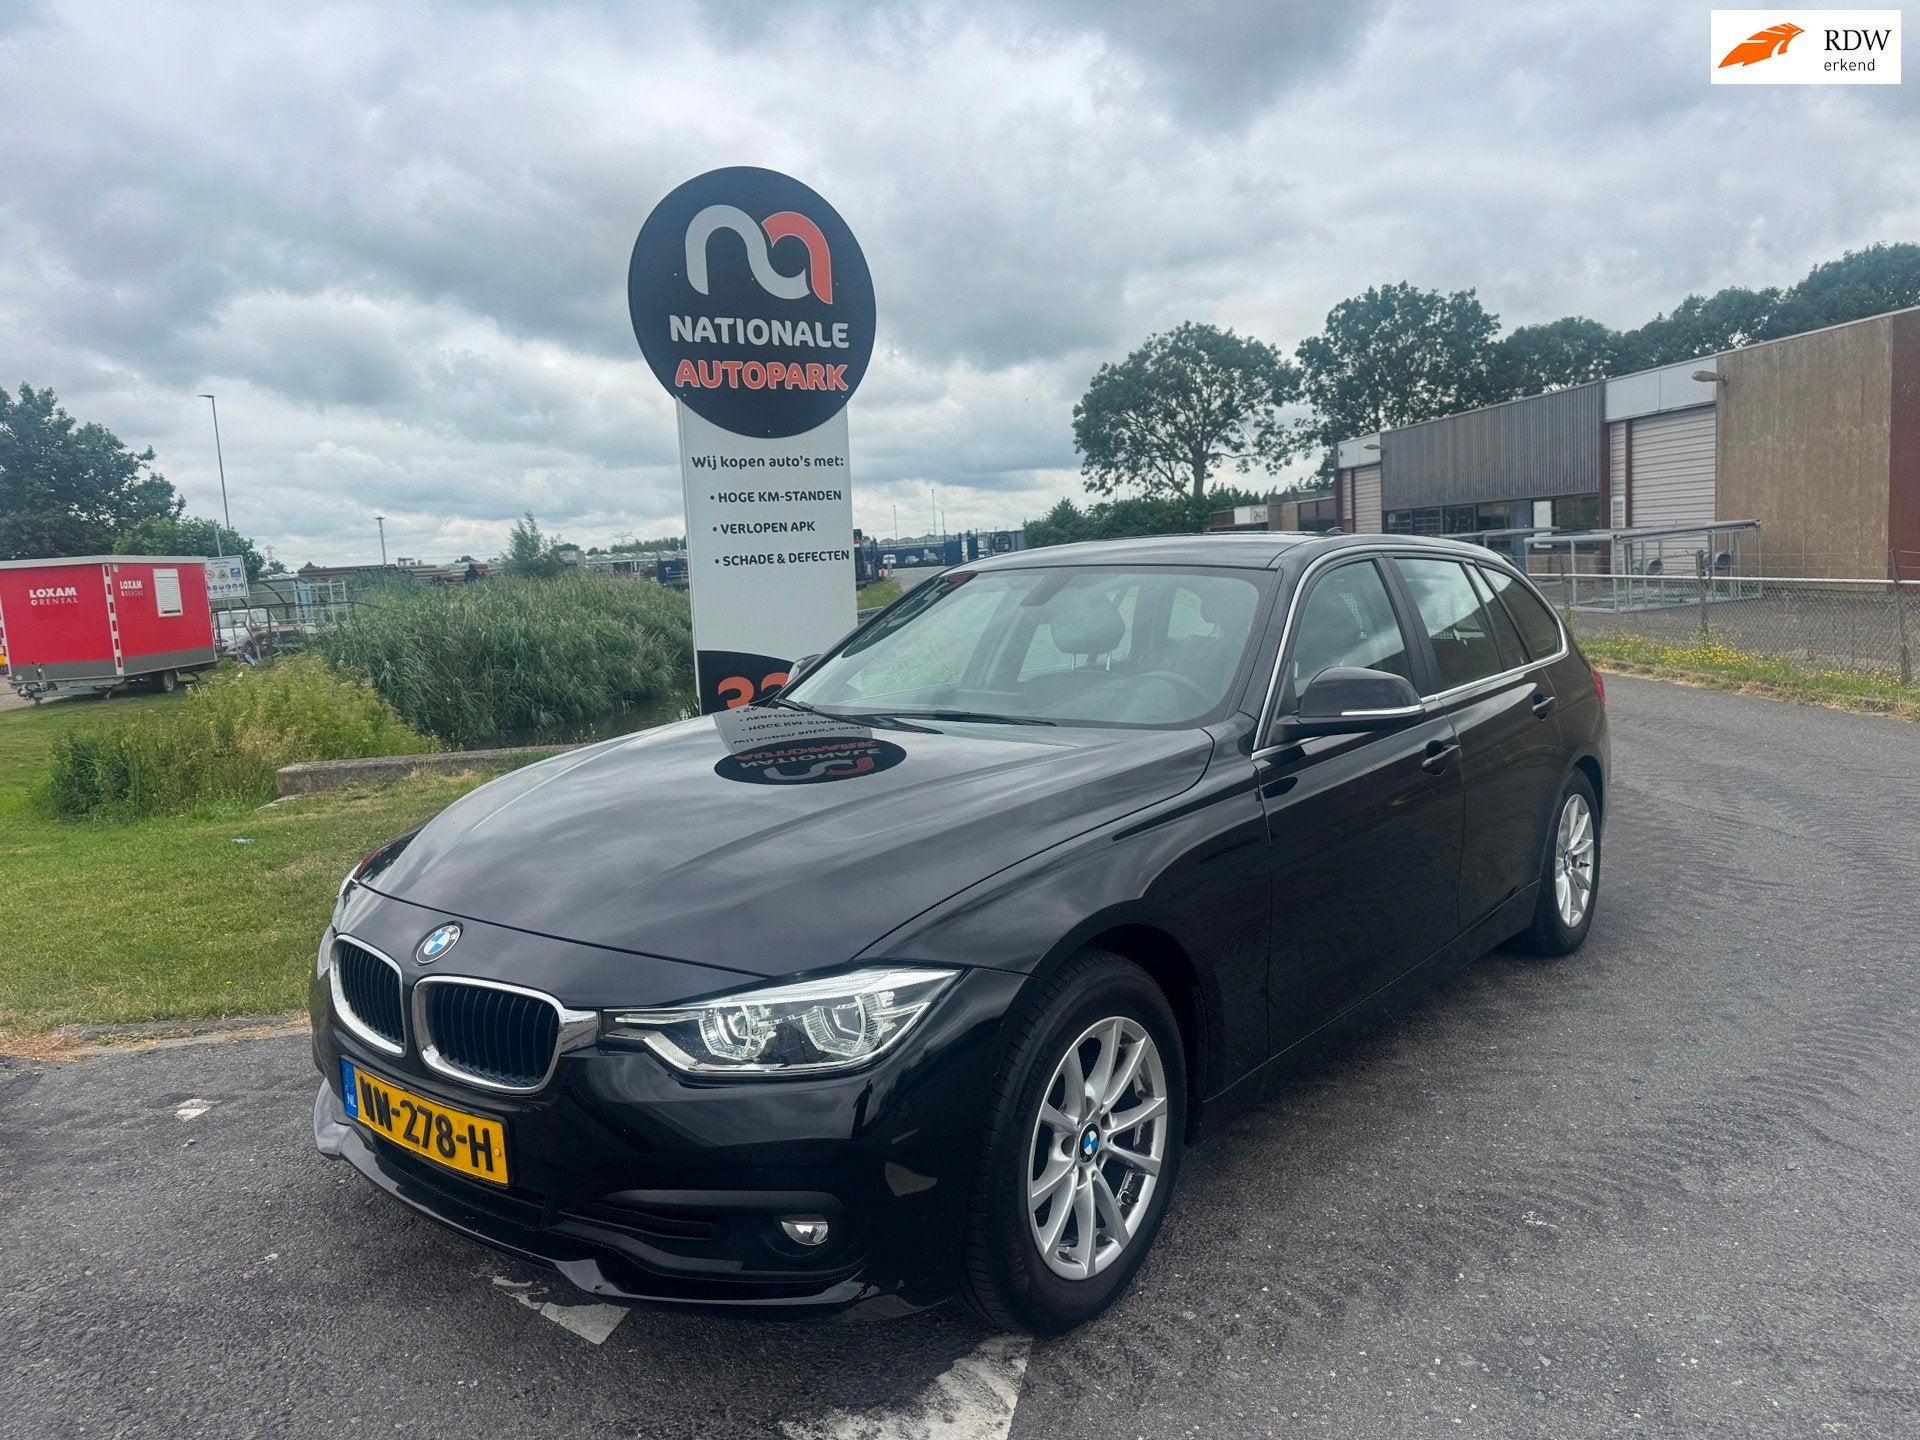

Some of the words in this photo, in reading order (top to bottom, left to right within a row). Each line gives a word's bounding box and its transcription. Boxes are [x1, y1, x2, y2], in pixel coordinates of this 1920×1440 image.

[669, 314, 850, 349] NATIONALE
[674, 358, 849, 391] AUTOPARK
[691, 454, 718, 471] Wij
[720, 455, 765, 470] kopen
[768, 454, 811, 468] auto's
[814, 456, 844, 467] met:
[718, 491, 755, 503] HOGE
[758, 490, 842, 502] KM-STANDEN
[720, 522, 788, 534] VERLOPEN
[790, 520, 816, 532] APK
[722, 553, 775, 567] SCHADE
[776, 553, 786, 564] &
[788, 549, 850, 563] DEFECTEN
[119, 580, 143, 589] LOXAM
[29, 586, 77, 598] LOXAM
[38, 598, 78, 606] RENTAL
